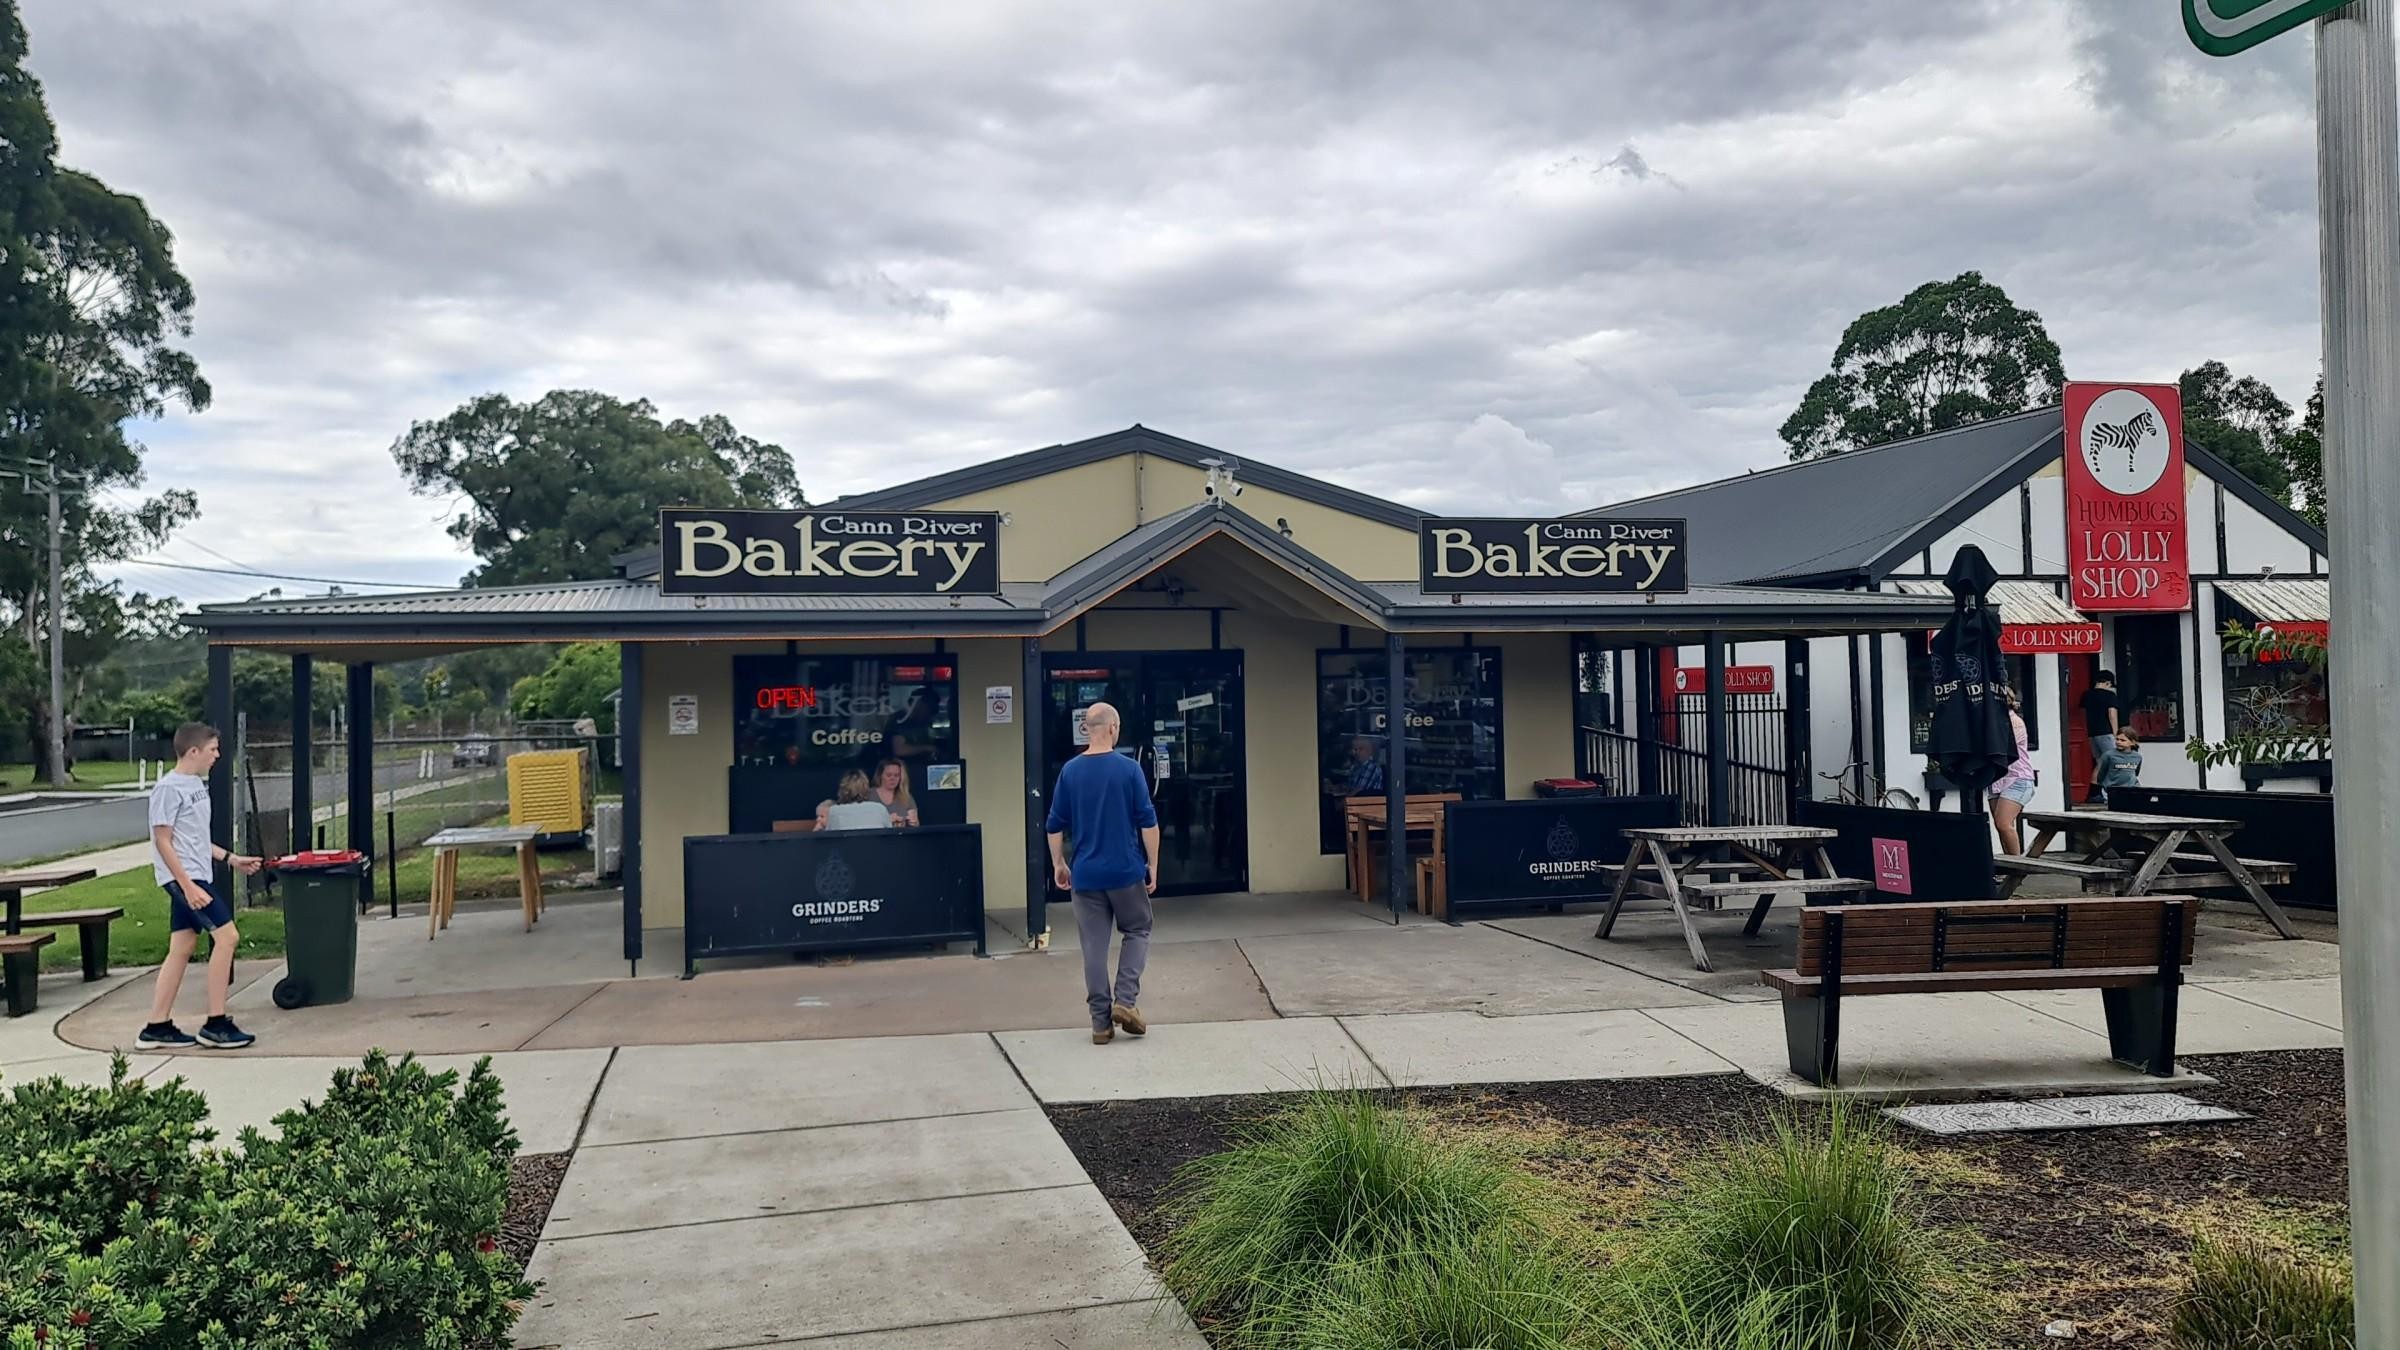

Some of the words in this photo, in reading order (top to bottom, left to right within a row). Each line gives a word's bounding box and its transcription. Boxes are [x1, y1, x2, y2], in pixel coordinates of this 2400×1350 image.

[2075, 495, 2178, 528] HUMBUGS
[820, 516, 894, 535] Cann
[902, 517, 983, 535] River
[1544, 523, 1601, 539] Cann
[1608, 524, 1673, 539] River
[674, 515, 986, 592] Bakery
[2083, 530, 2173, 562] LOLLY
[1431, 523, 1676, 590] Bakery
[2081, 567, 2159, 599] SHOP
[2014, 630, 2057, 646] LOLLY
[2060, 629, 2099, 646] SHOP
[1725, 672, 1746, 686] OLLY
[1746, 671, 1771, 686] SHOP
[756, 687, 816, 709] OPEN
[1374, 713, 1435, 728] Cfee
[811, 728, 883, 745] Coffee
[1881, 844, 1901, 870] M
[1529, 860, 1597, 874] GRINDERS
[791, 899, 881, 917] GRINDERS
